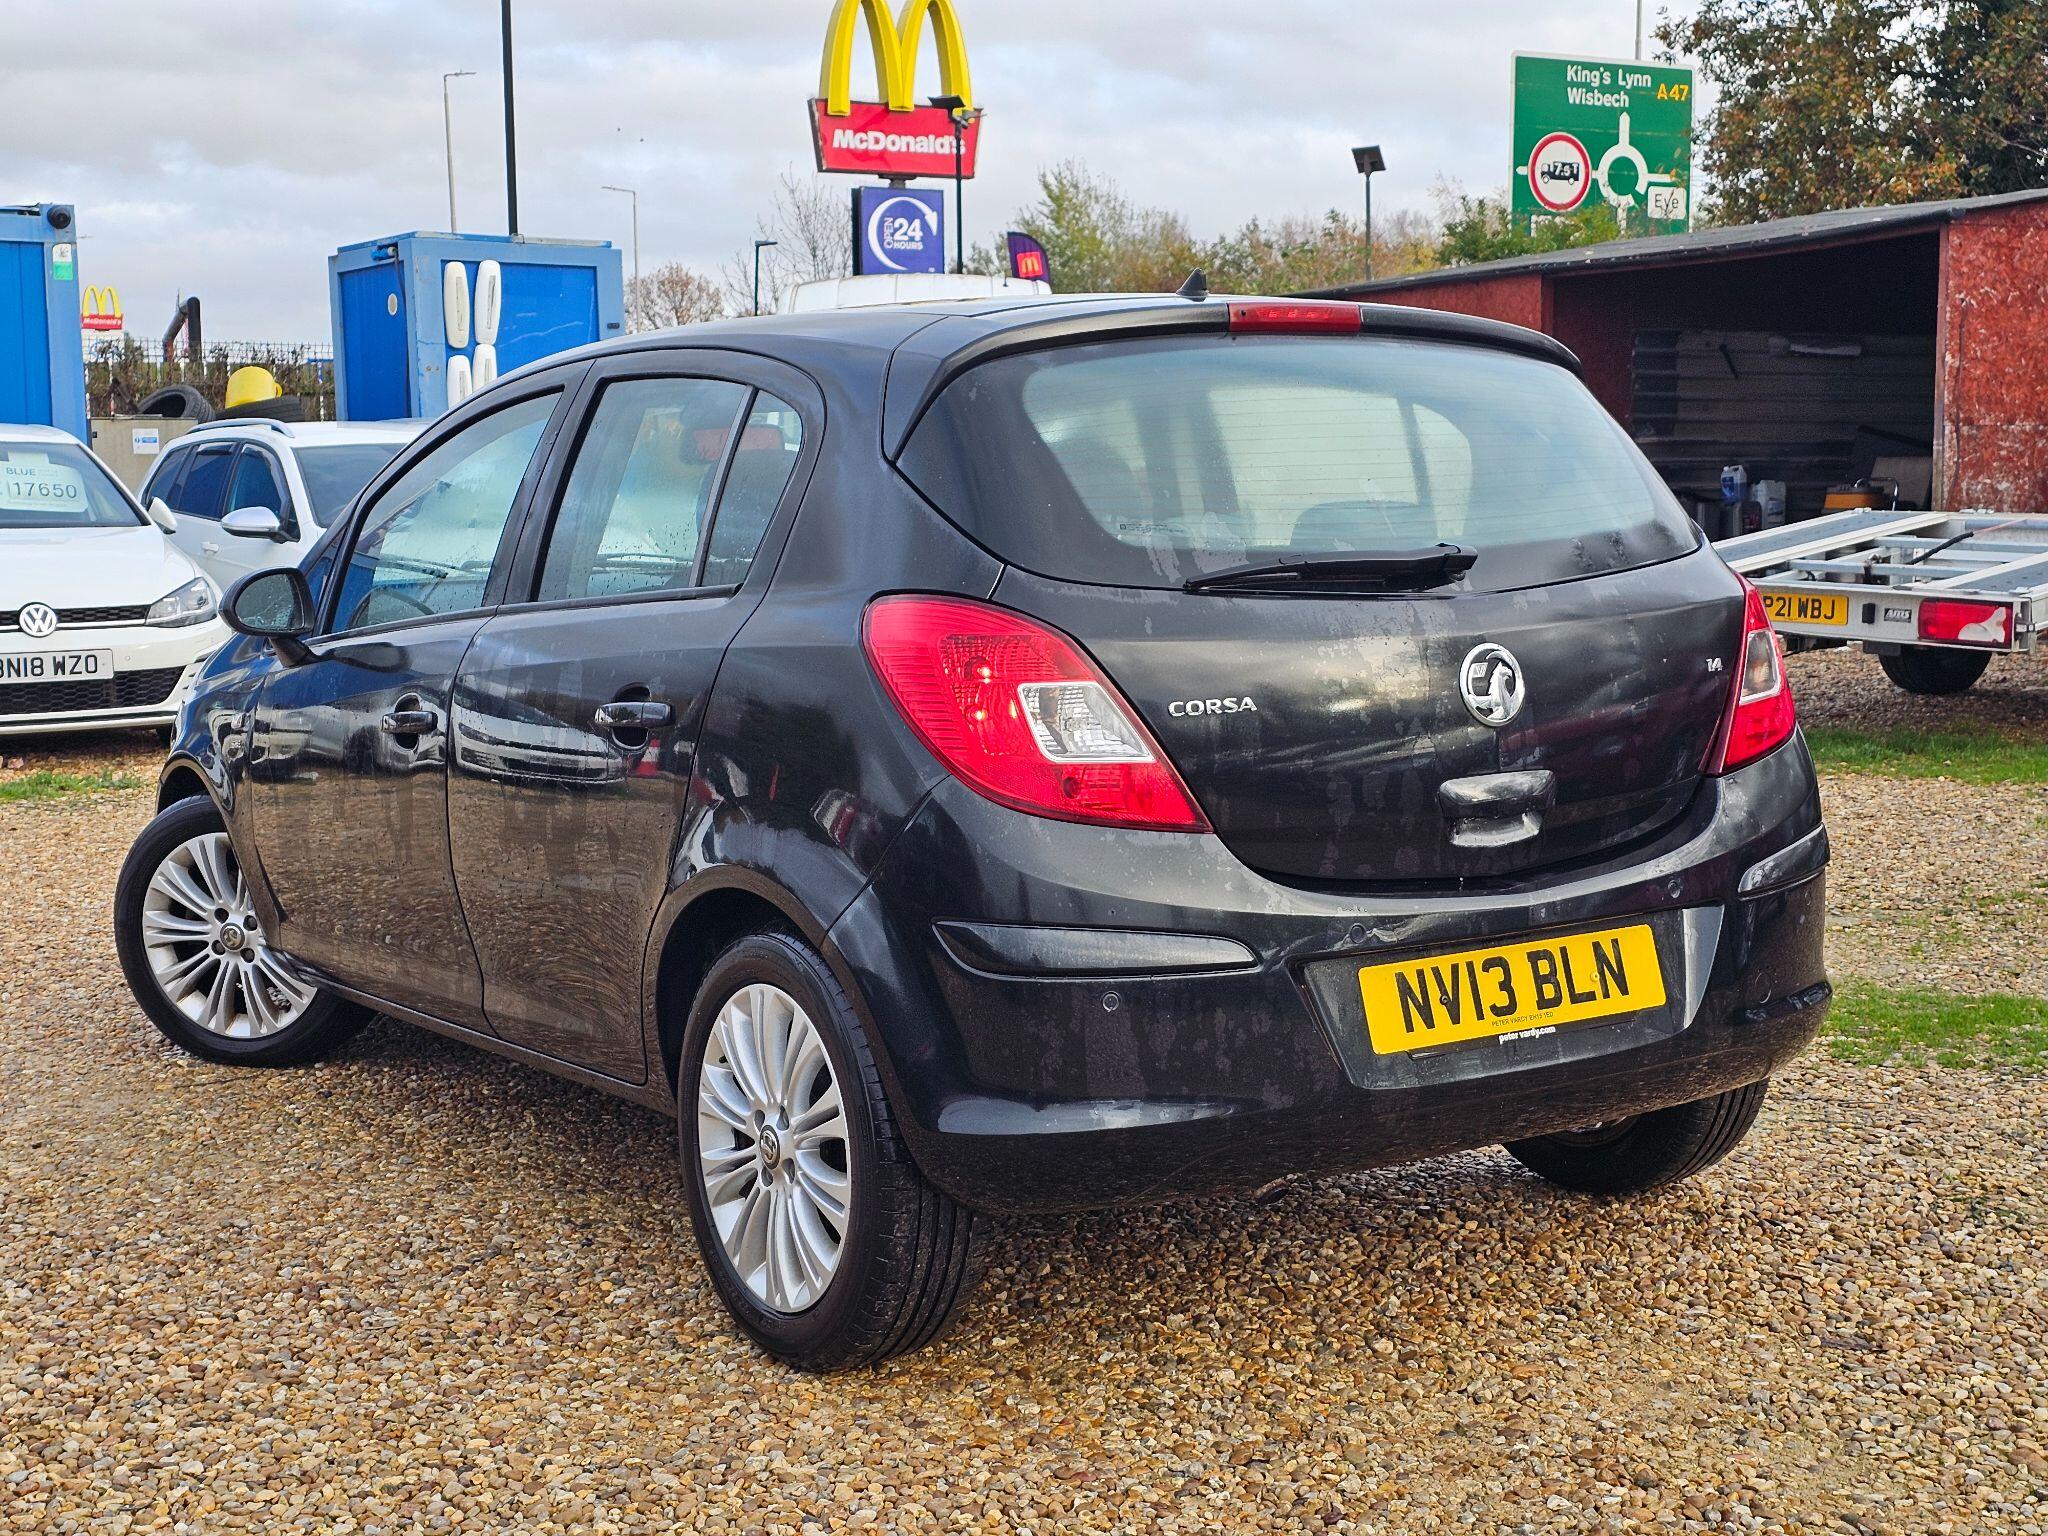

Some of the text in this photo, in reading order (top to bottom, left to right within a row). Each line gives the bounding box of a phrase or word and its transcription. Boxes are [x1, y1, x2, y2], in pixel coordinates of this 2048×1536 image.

[1566, 65, 1652, 89] King's Lynn
[1567, 87, 1630, 107] Wisbech
[1656, 83, 1690, 101] A47
[832, 129, 966, 155] McDonald's
[1654, 193, 1679, 214] Eye
[883, 217, 893, 249] OPEN
[893, 217, 923, 241] 24
[893, 241, 923, 250] HOURS
[6, 467, 37, 476] BLUE
[13, 482, 77, 499] 17650
[1798, 597, 1835, 619] WBJ
[52, 654, 98, 676] WZO
[1168, 696, 1258, 717] CORSA
[1394, 937, 1630, 1034] NV13 BLN
[1491, 1018, 1510, 1027] PETER
[1498, 1026, 1556, 1045] peter vardy.com
